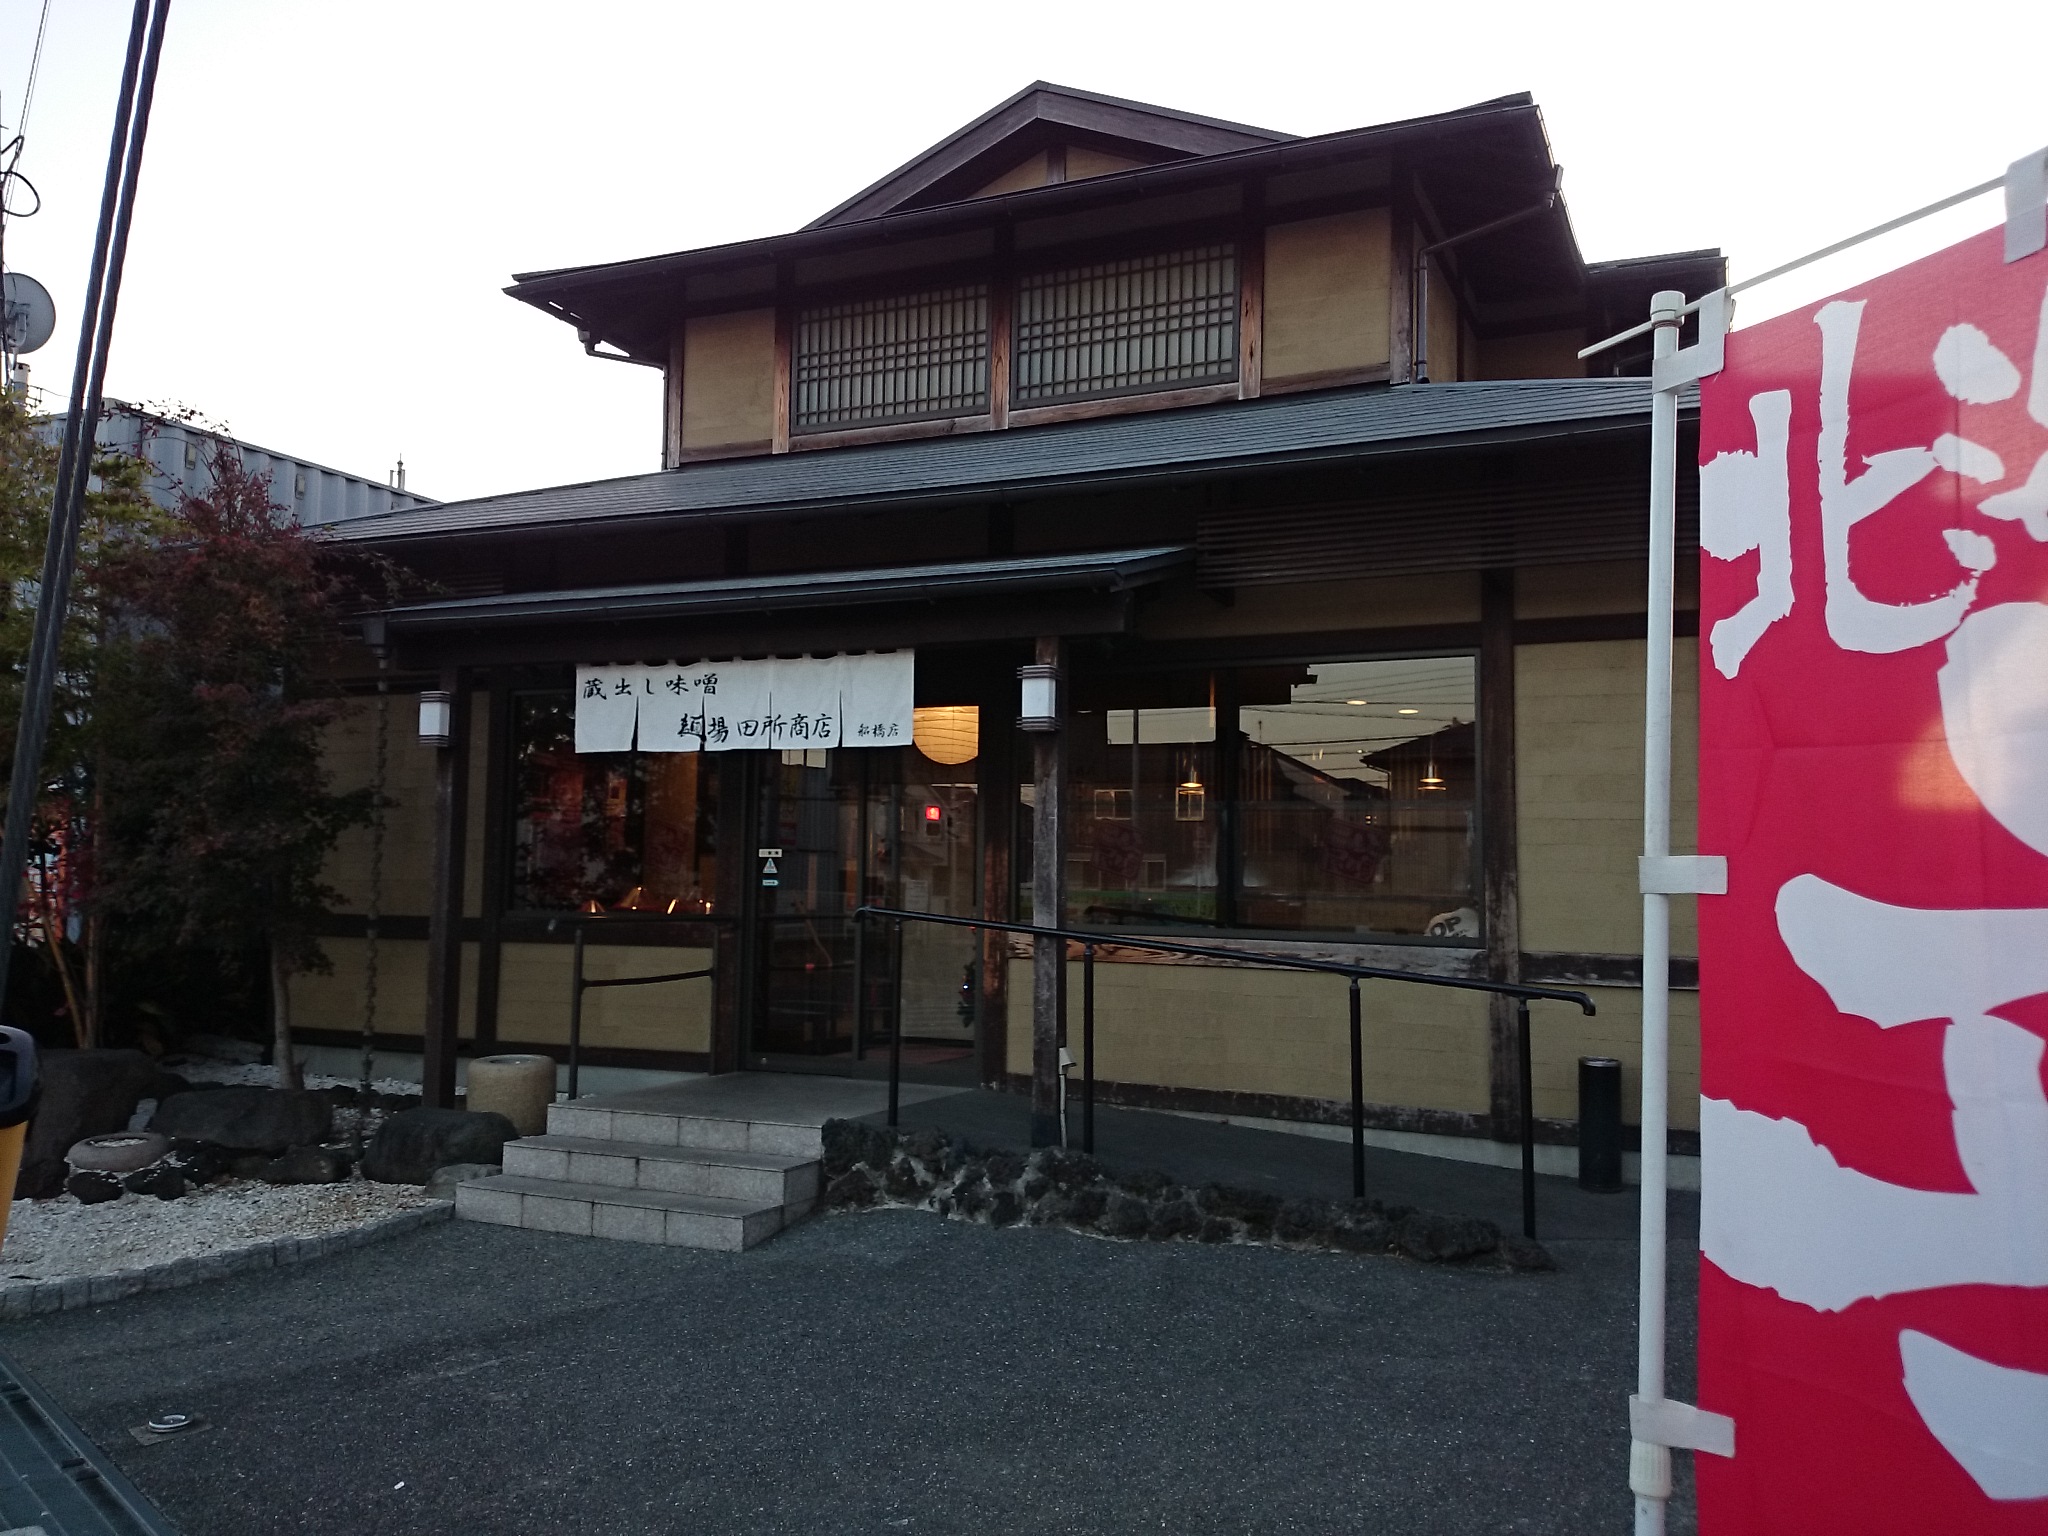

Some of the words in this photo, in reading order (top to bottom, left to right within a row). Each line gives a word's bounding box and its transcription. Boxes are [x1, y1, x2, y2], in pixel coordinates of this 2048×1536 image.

[583, 673, 719, 701] 蔵出し味噌
